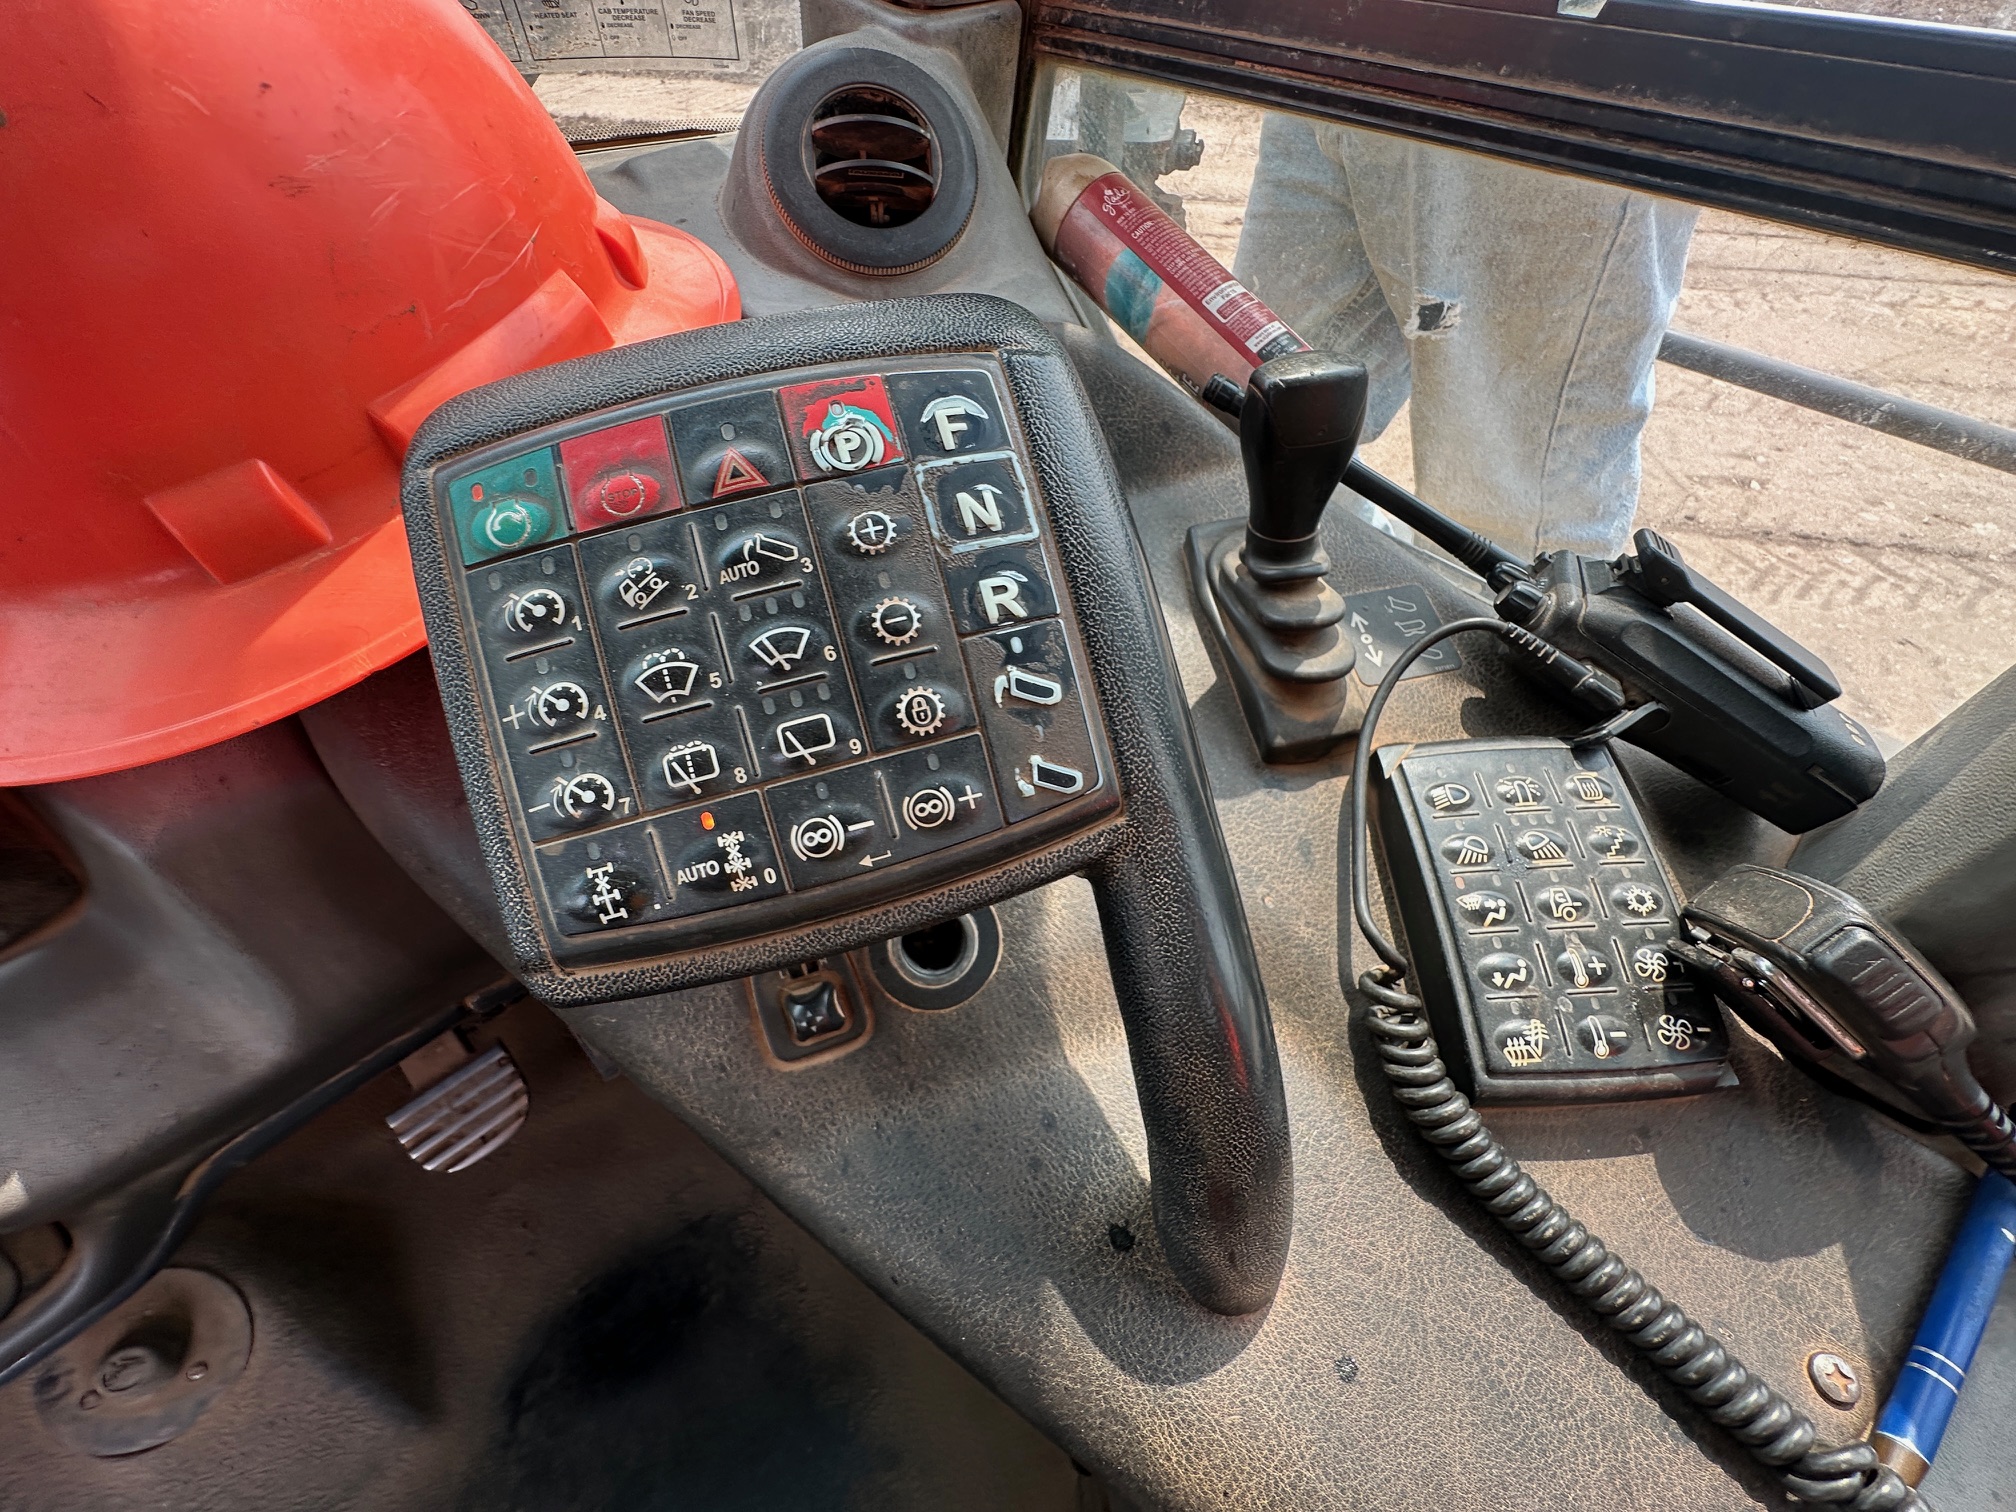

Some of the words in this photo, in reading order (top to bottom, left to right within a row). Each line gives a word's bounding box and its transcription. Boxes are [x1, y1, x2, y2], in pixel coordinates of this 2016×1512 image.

[934, 407, 968, 450] F
[832, 429, 860, 463] P
[956, 489, 1002, 536] N
[719, 560, 760, 585] AUTO
[801, 557, 813, 572] 3
[685, 583, 698, 600] 2
[979, 576, 1027, 624] R
[571, 615, 582, 631] 1
[823, 645, 837, 661] 6
[709, 672, 722, 688] 5
[594, 705, 606, 720] 4
[849, 739, 862, 755] 9
[733, 767, 747, 783] 8
[618, 797, 631, 813] 7
[677, 860, 720, 885] AUTO
[763, 867, 777, 884] 0
